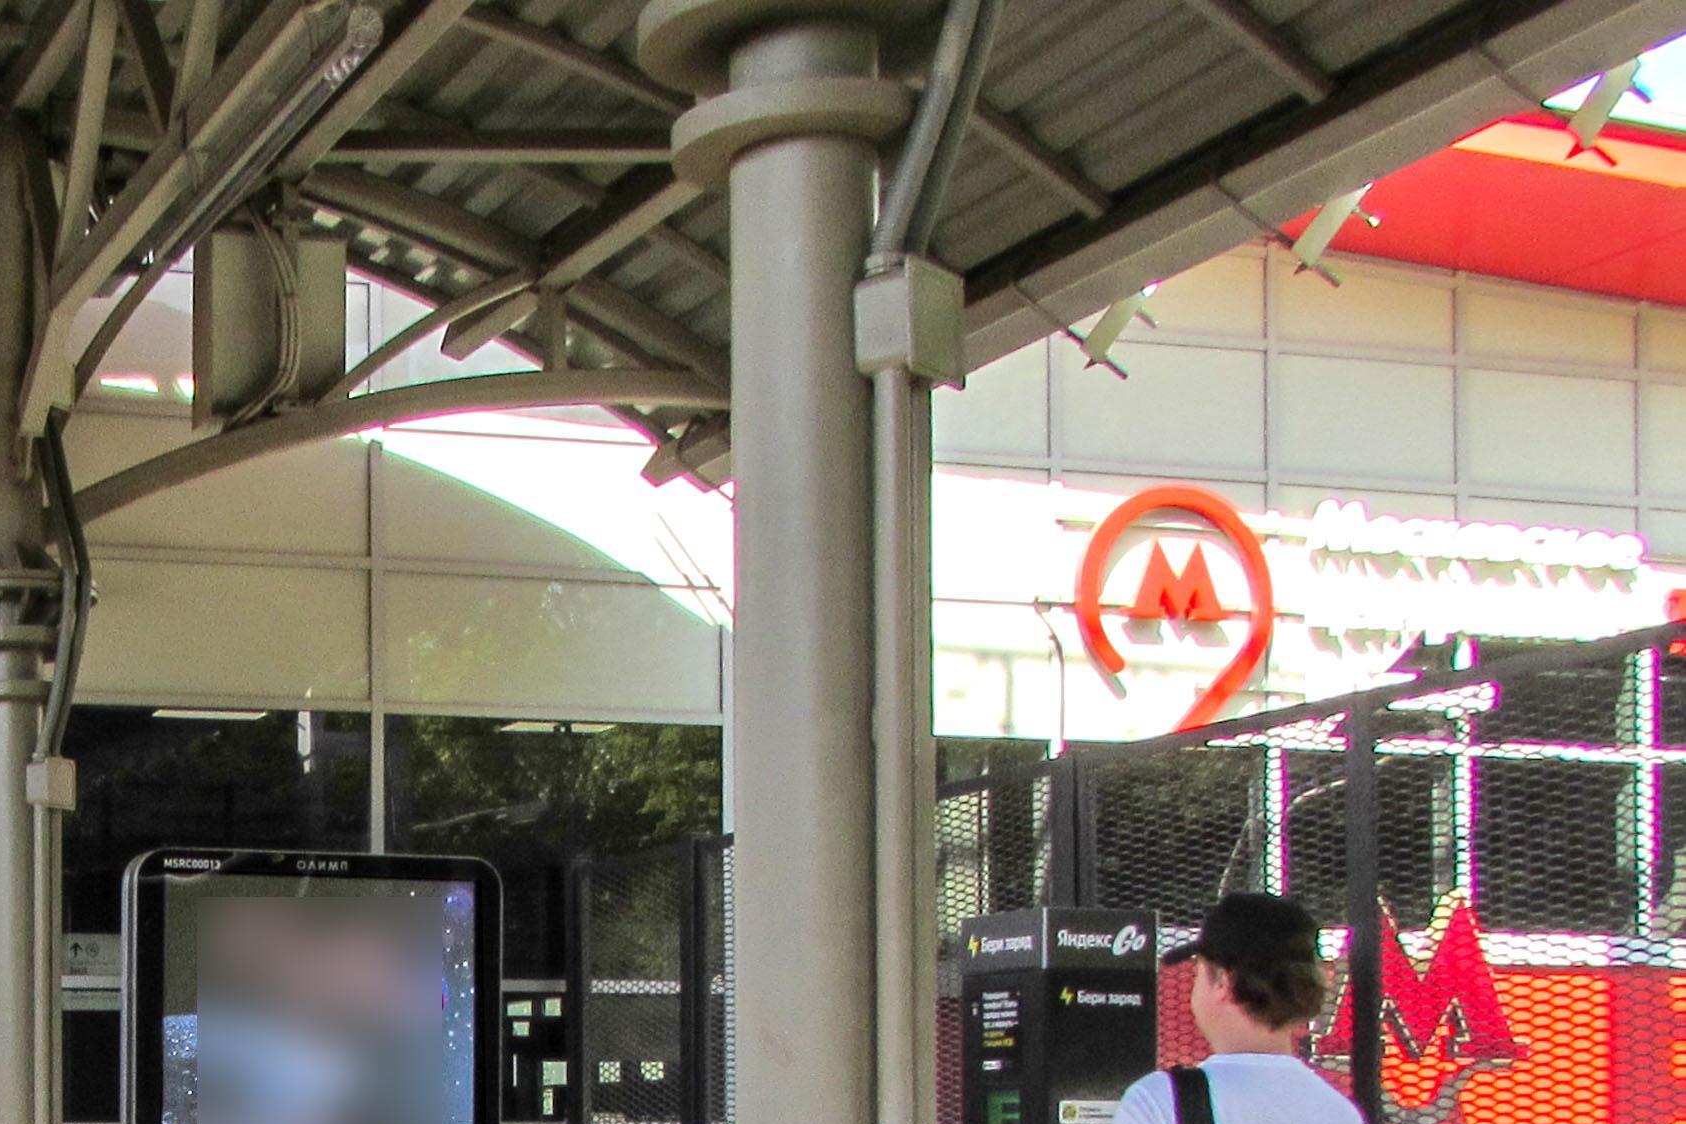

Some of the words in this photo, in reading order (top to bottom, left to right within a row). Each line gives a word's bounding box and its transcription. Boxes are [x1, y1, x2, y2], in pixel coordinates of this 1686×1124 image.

[1057, 929, 1112, 950] Яндекс
[1112, 925, 1146, 955] Go
[1077, 989, 1106, 1005] Бери
